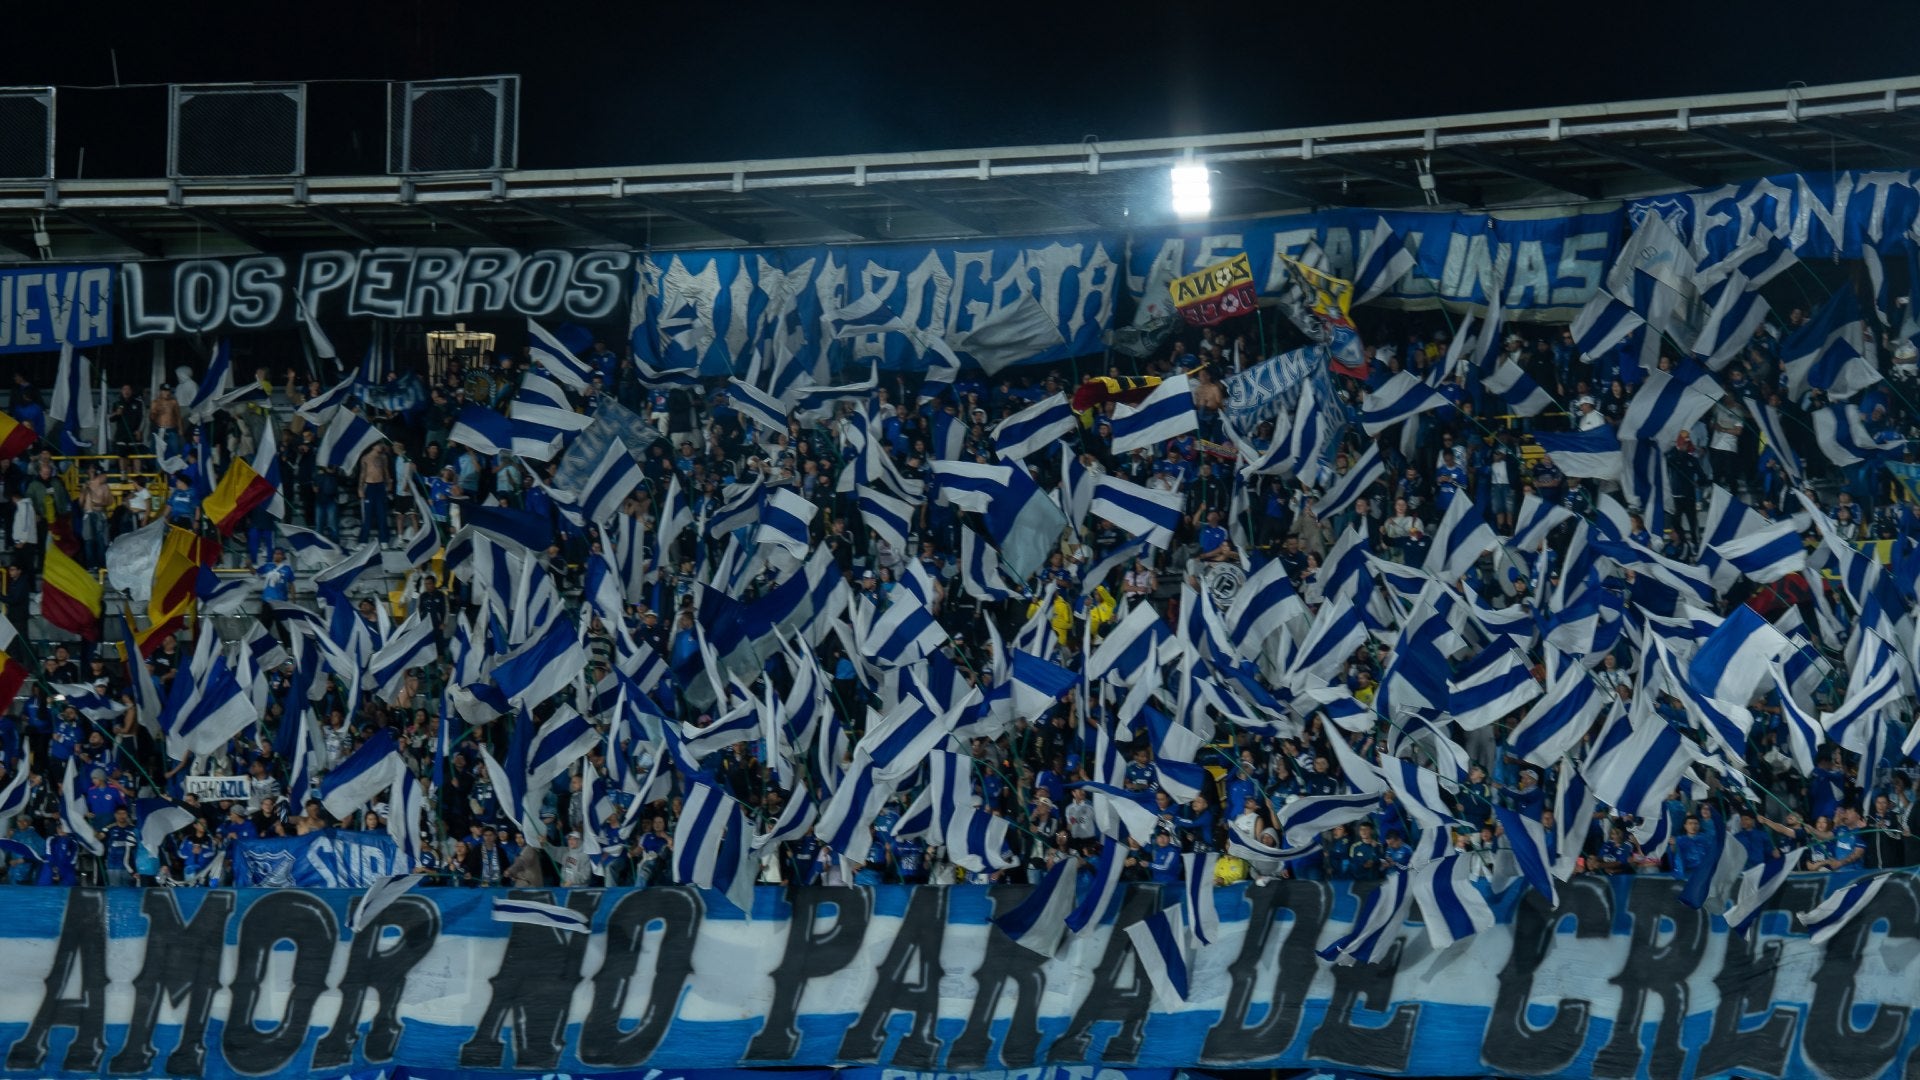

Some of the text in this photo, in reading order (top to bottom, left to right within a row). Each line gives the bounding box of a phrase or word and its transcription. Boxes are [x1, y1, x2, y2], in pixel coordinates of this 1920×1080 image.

[1688, 170, 1920, 262] FONT
[121, 256, 286, 340] LOS
[297, 246, 632, 319] PERROS
[5, 872, 1920, 1080] AMOR NO PARA DE CREC
